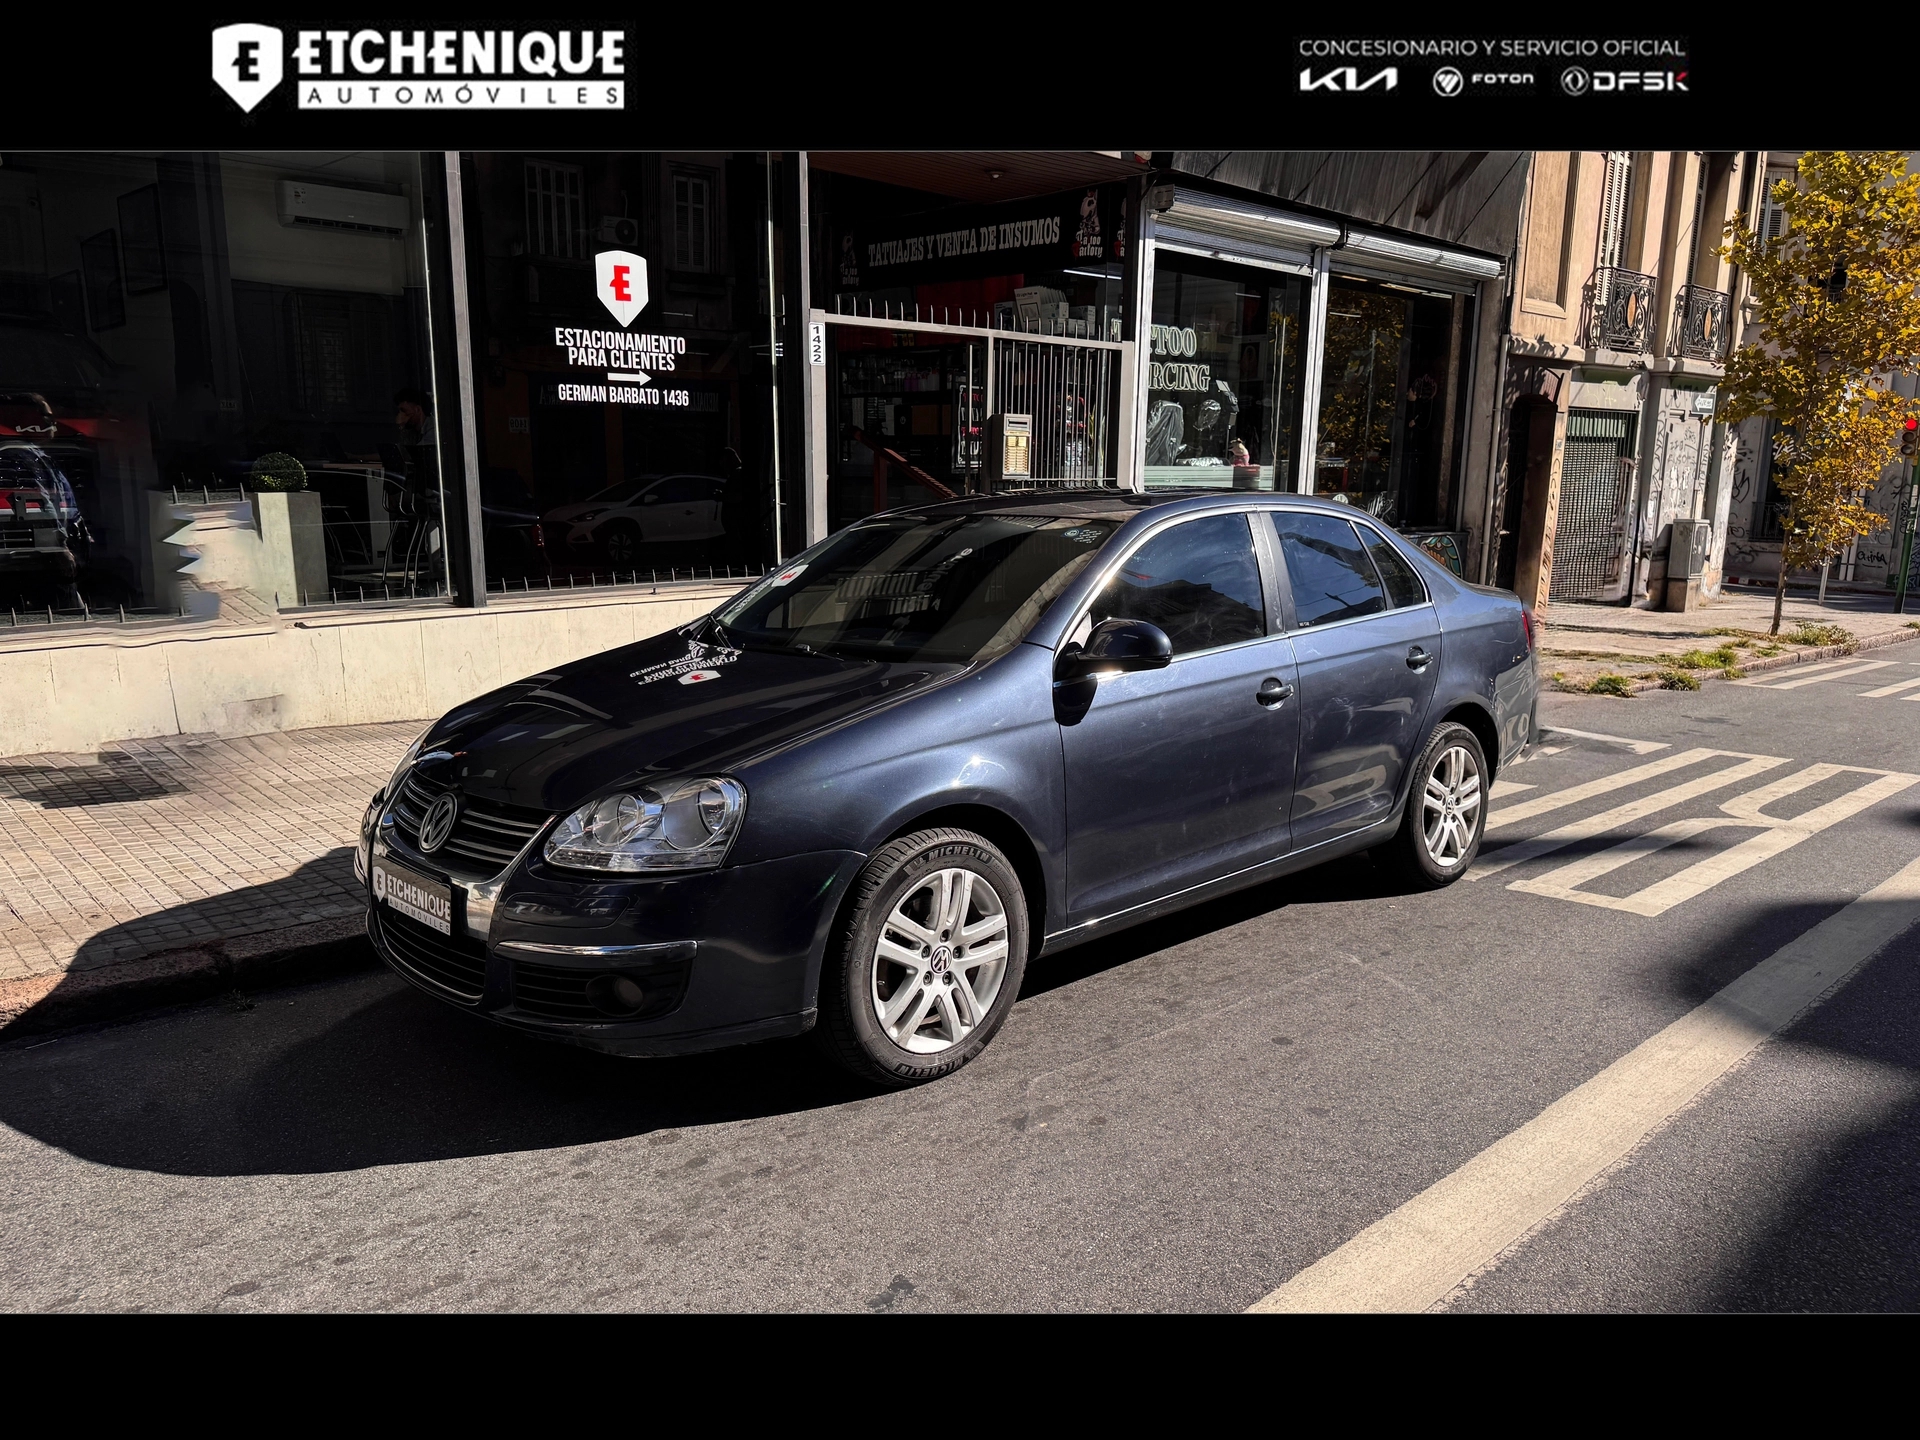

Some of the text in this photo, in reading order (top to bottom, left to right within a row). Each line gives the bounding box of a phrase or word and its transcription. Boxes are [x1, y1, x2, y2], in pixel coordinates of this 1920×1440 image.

[868, 215, 1061, 267] TATUAJES Y VENTA DE INSUMOS
[555, 327, 686, 355] ESTACIONAMIENTO
[812, 325, 822, 363] 1422
[568, 347, 676, 371] PARA CLIENTES
[558, 384, 606, 403] GERMAN
[609, 386, 659, 405] BARBATO
[663, 389, 689, 406] 1436
[929, 846, 990, 862] MICHELIN
[387, 874, 451, 920] ETCHENIQUE
[897, 1057, 964, 1078] MICHELIN
